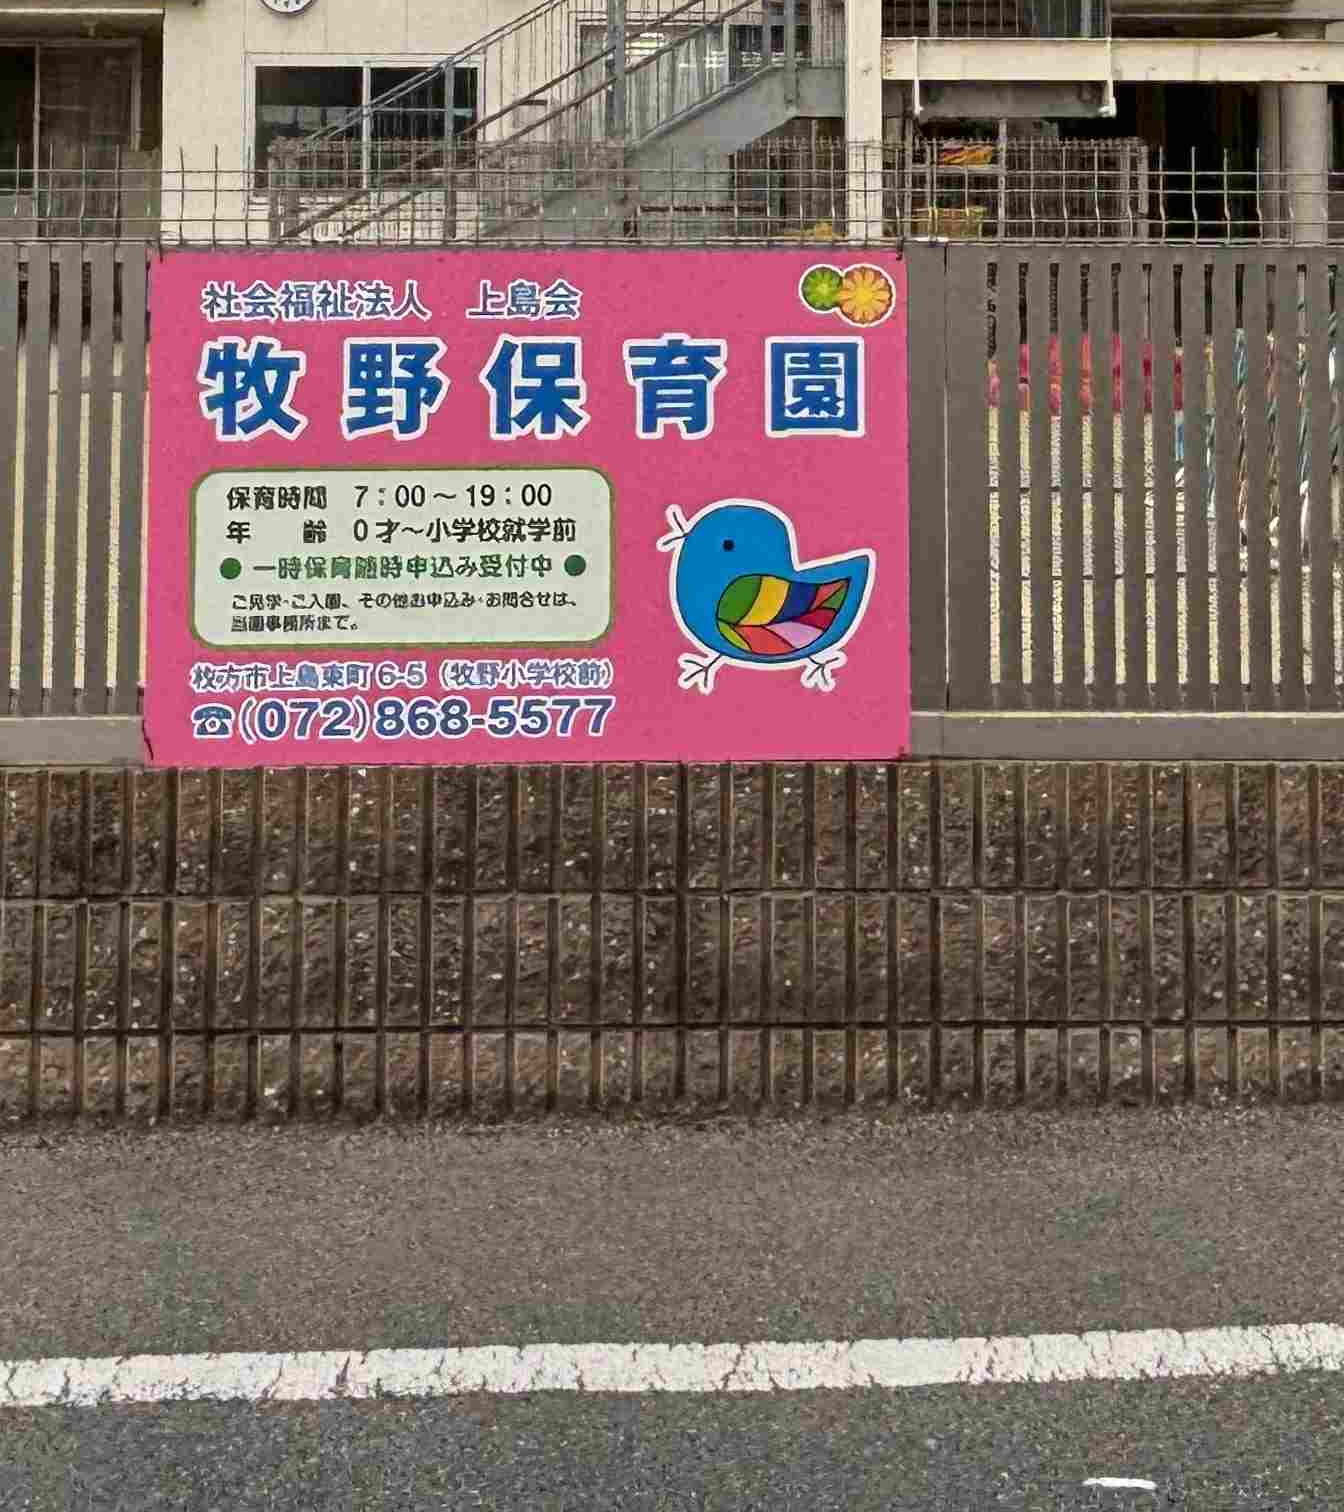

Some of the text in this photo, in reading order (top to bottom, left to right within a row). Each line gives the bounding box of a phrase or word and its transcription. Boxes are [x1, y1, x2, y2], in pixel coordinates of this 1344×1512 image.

[202, 279, 583, 322] 社会福祉法人 上島会
[198, 334, 865, 441] 牧野保育園
[226, 485, 328, 510] 保育時間
[252, 554, 553, 580] 一時保育随時申込み受付中
